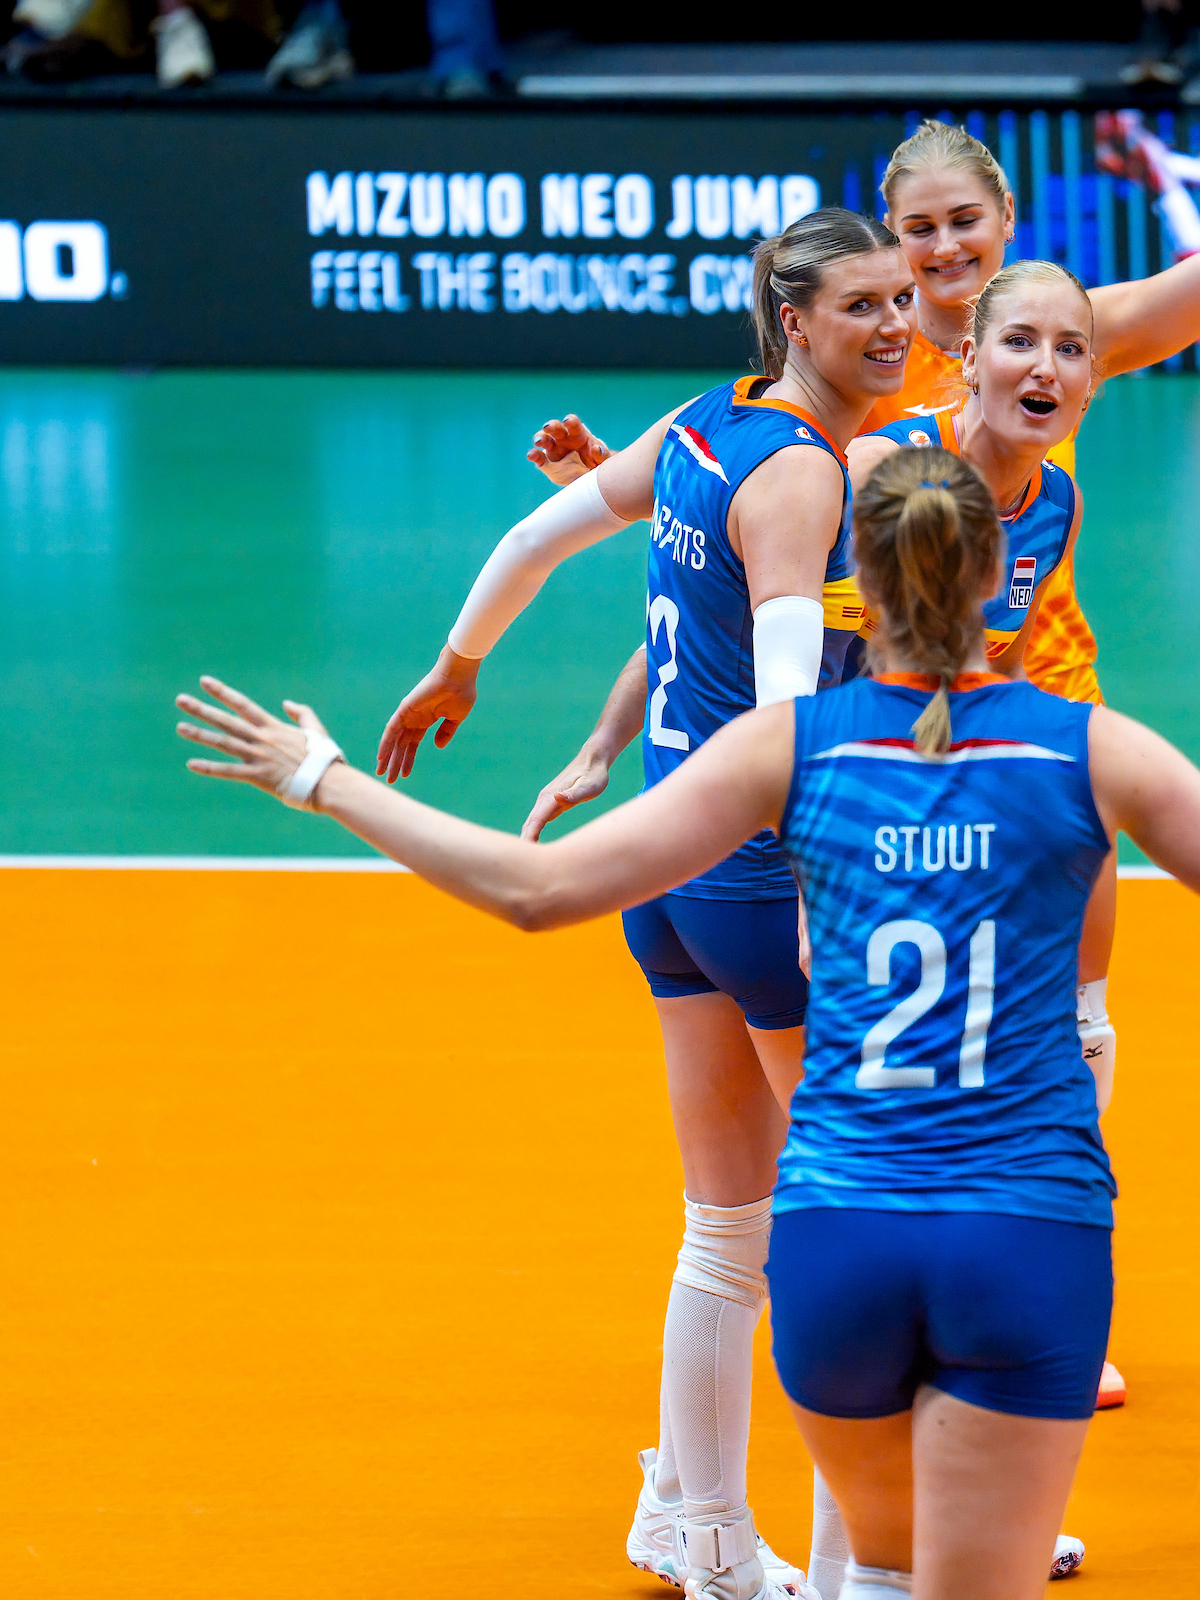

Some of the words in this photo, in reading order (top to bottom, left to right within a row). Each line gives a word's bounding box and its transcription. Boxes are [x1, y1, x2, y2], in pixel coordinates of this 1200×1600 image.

[306, 171, 527, 239] MIZUNO
[540, 172, 655, 240] NEO
[665, 174, 820, 240] JUMP
[310, 250, 412, 312] FEEL
[411, 252, 498, 313] THE
[1009, 587, 1031, 606] NED
[874, 823, 997, 873] STUUT
[855, 919, 996, 1090] 21
